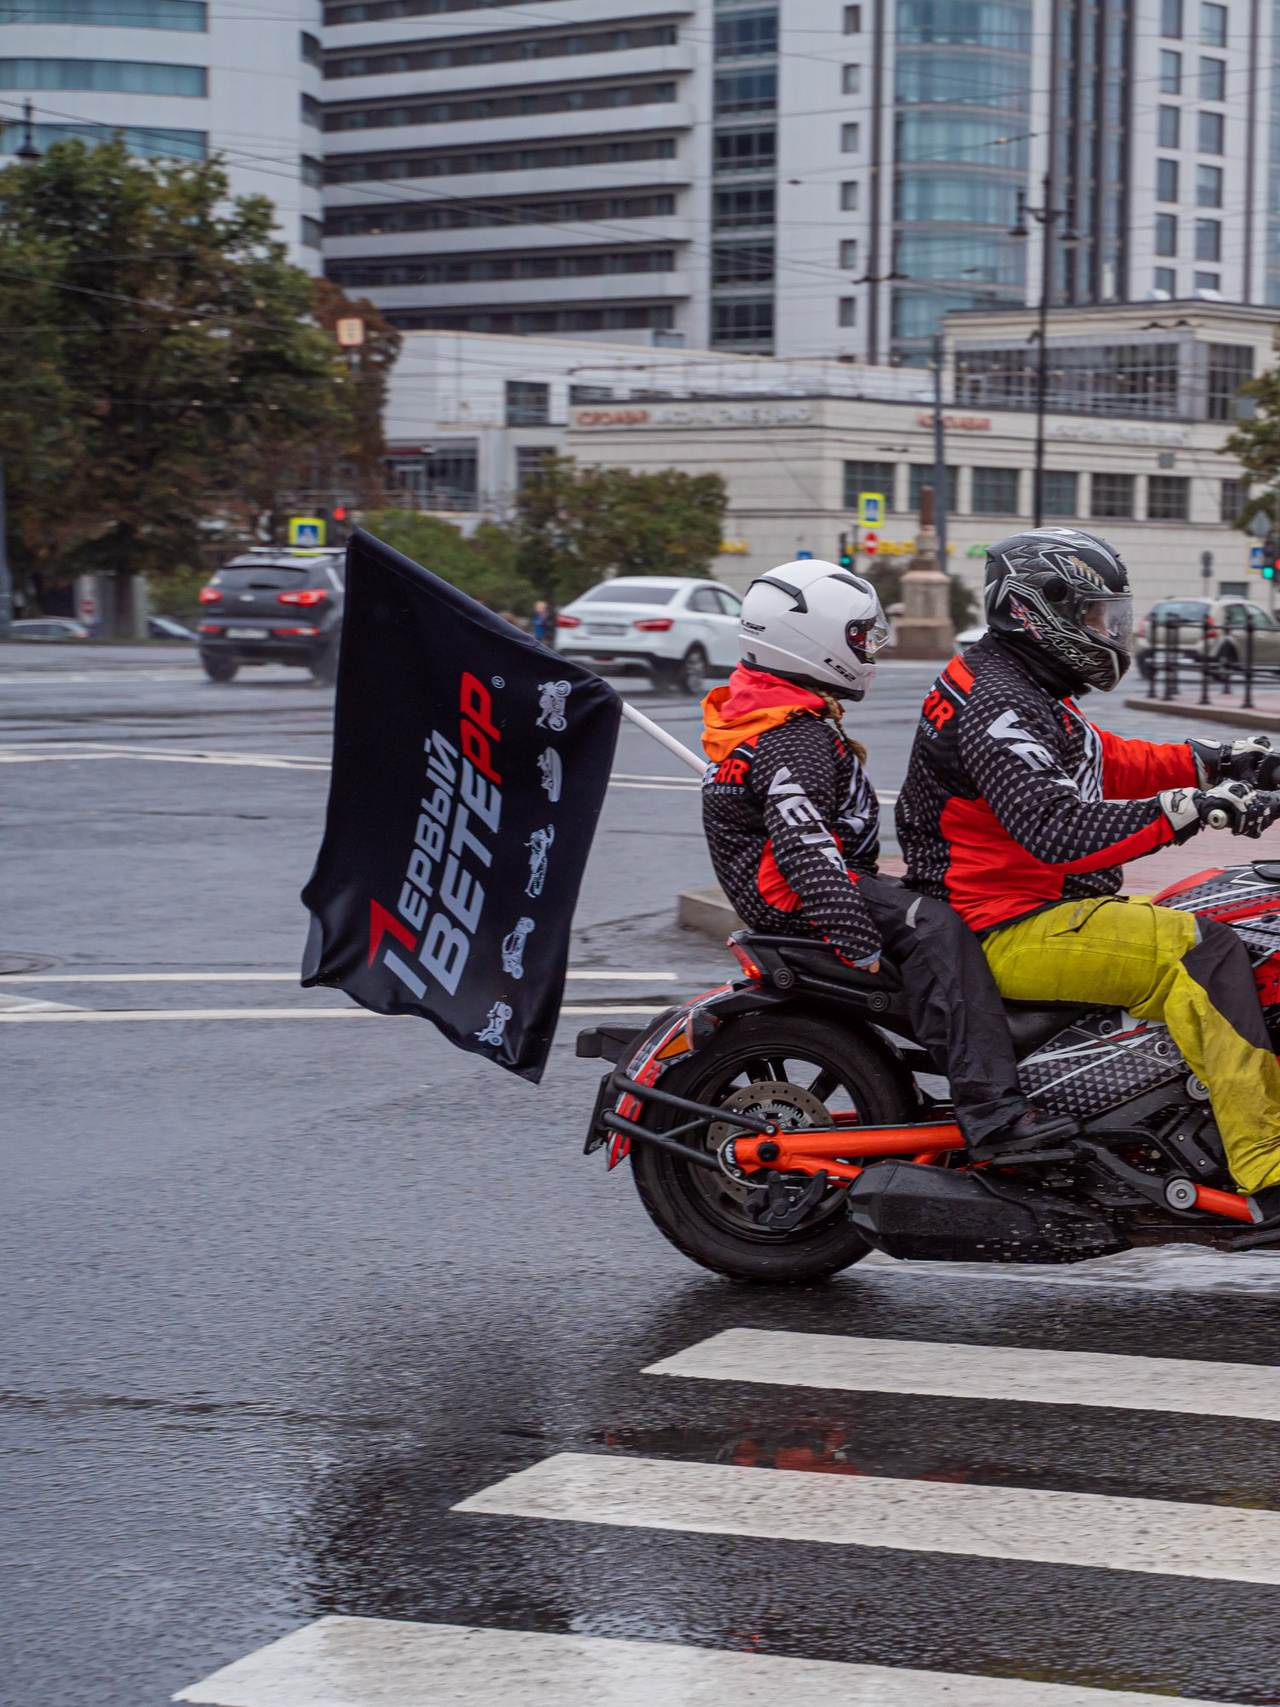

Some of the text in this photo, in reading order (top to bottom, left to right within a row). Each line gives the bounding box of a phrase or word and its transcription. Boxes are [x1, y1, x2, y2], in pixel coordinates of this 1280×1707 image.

[741, 619, 766, 632] LS2
[1024, 610, 1102, 667] SHARK
[823, 657, 856, 682] LS2
[418, 671, 502, 996] ВЕТЕРР
